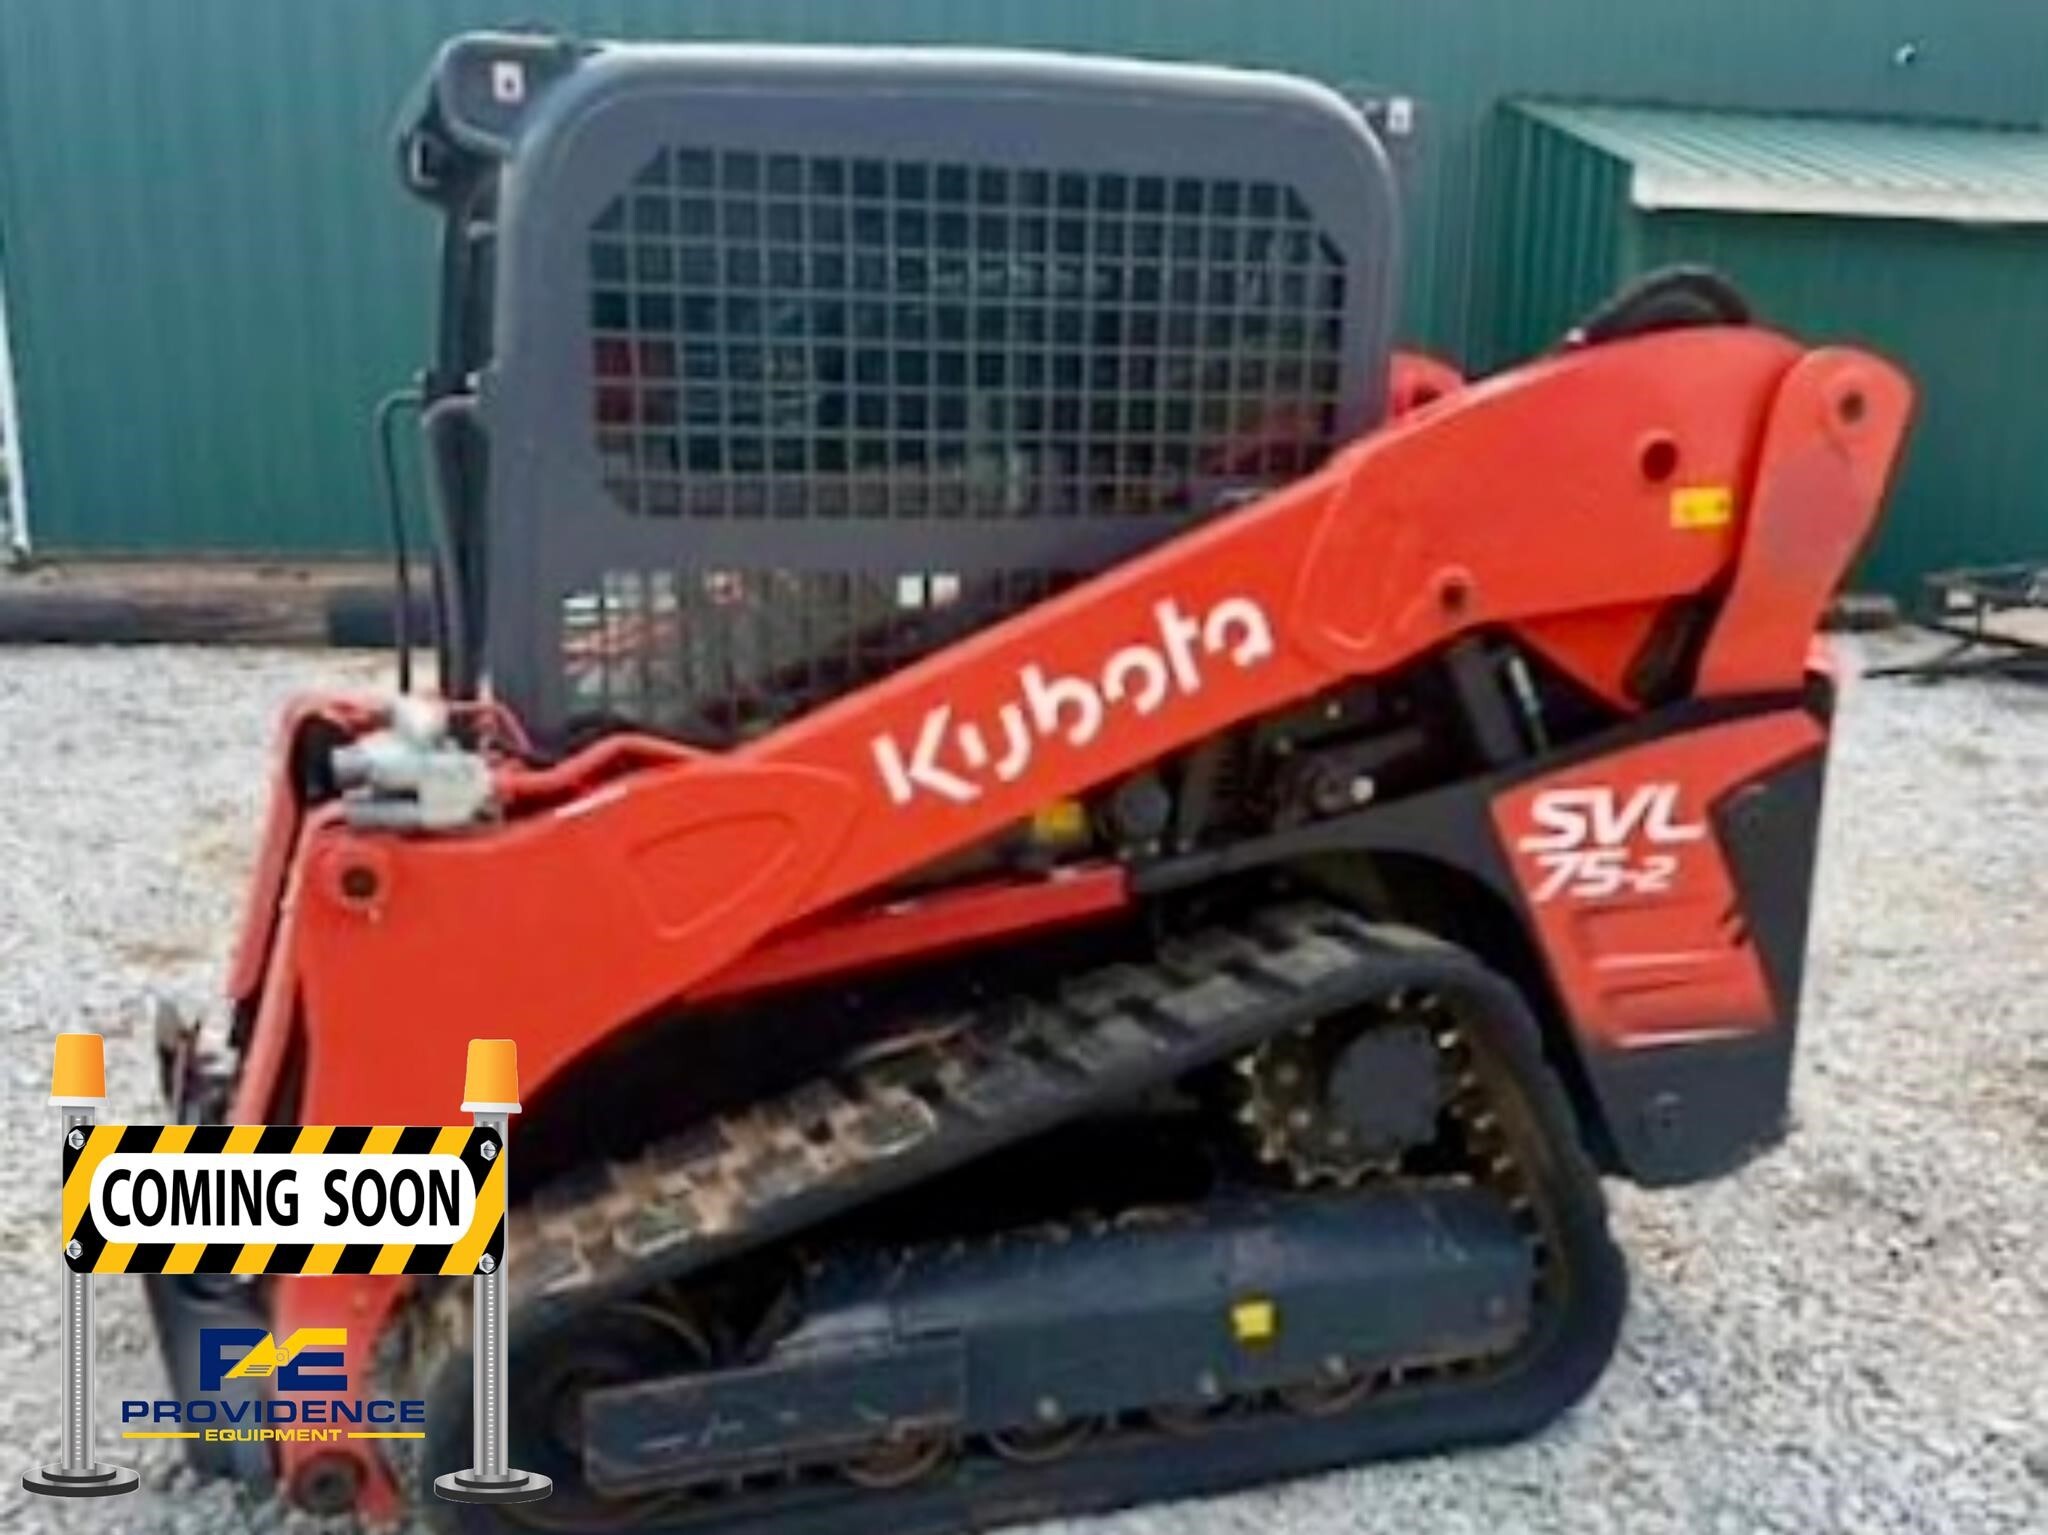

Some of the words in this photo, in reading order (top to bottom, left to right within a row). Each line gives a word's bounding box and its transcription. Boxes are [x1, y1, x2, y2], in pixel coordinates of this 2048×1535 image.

[872, 598, 1273, 804] Kubota
[1518, 783, 1708, 851] SVL
[1532, 851, 1678, 902] 75-2
